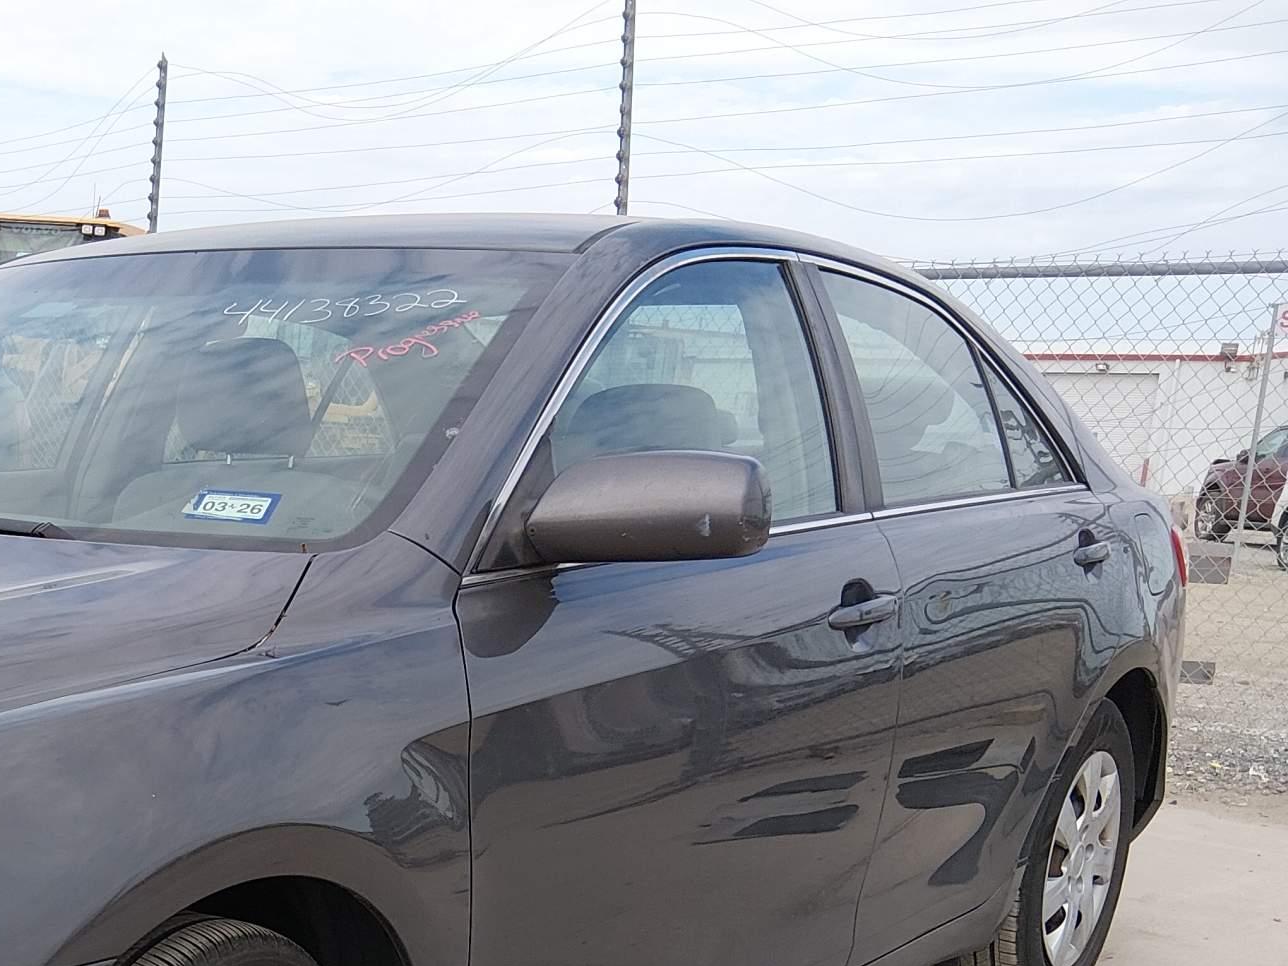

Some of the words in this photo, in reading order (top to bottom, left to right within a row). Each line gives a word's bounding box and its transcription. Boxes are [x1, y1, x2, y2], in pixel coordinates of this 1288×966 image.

[222, 288, 468, 326] 44138322
[202, 500, 228, 513] 03
[236, 502, 264, 515] 26
